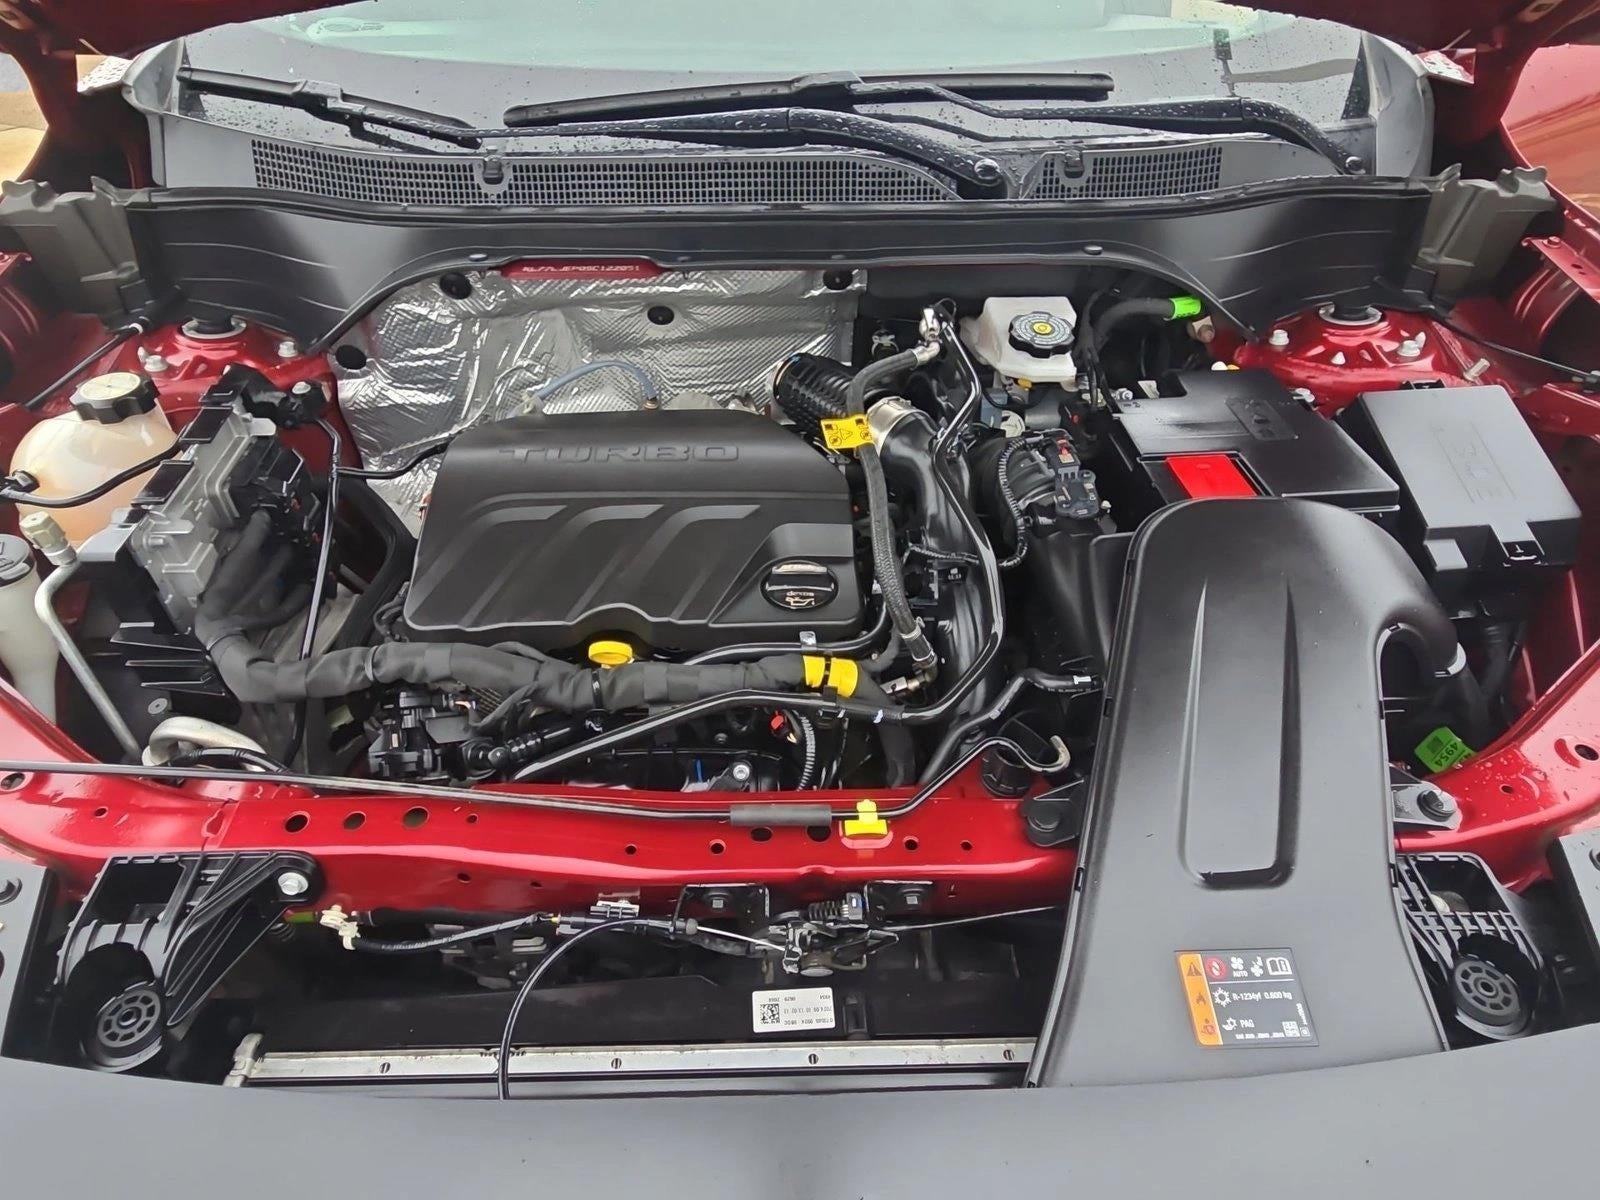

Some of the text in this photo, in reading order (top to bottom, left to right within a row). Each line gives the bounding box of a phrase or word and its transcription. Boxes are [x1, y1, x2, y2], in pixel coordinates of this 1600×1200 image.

[499, 446, 739, 463] TURBO
[1434, 742, 1458, 767] 4954
[1232, 970, 1248, 978] AUTO
[1283, 991, 1293, 1000] kg
[1239, 1019, 1255, 1028] PAG
